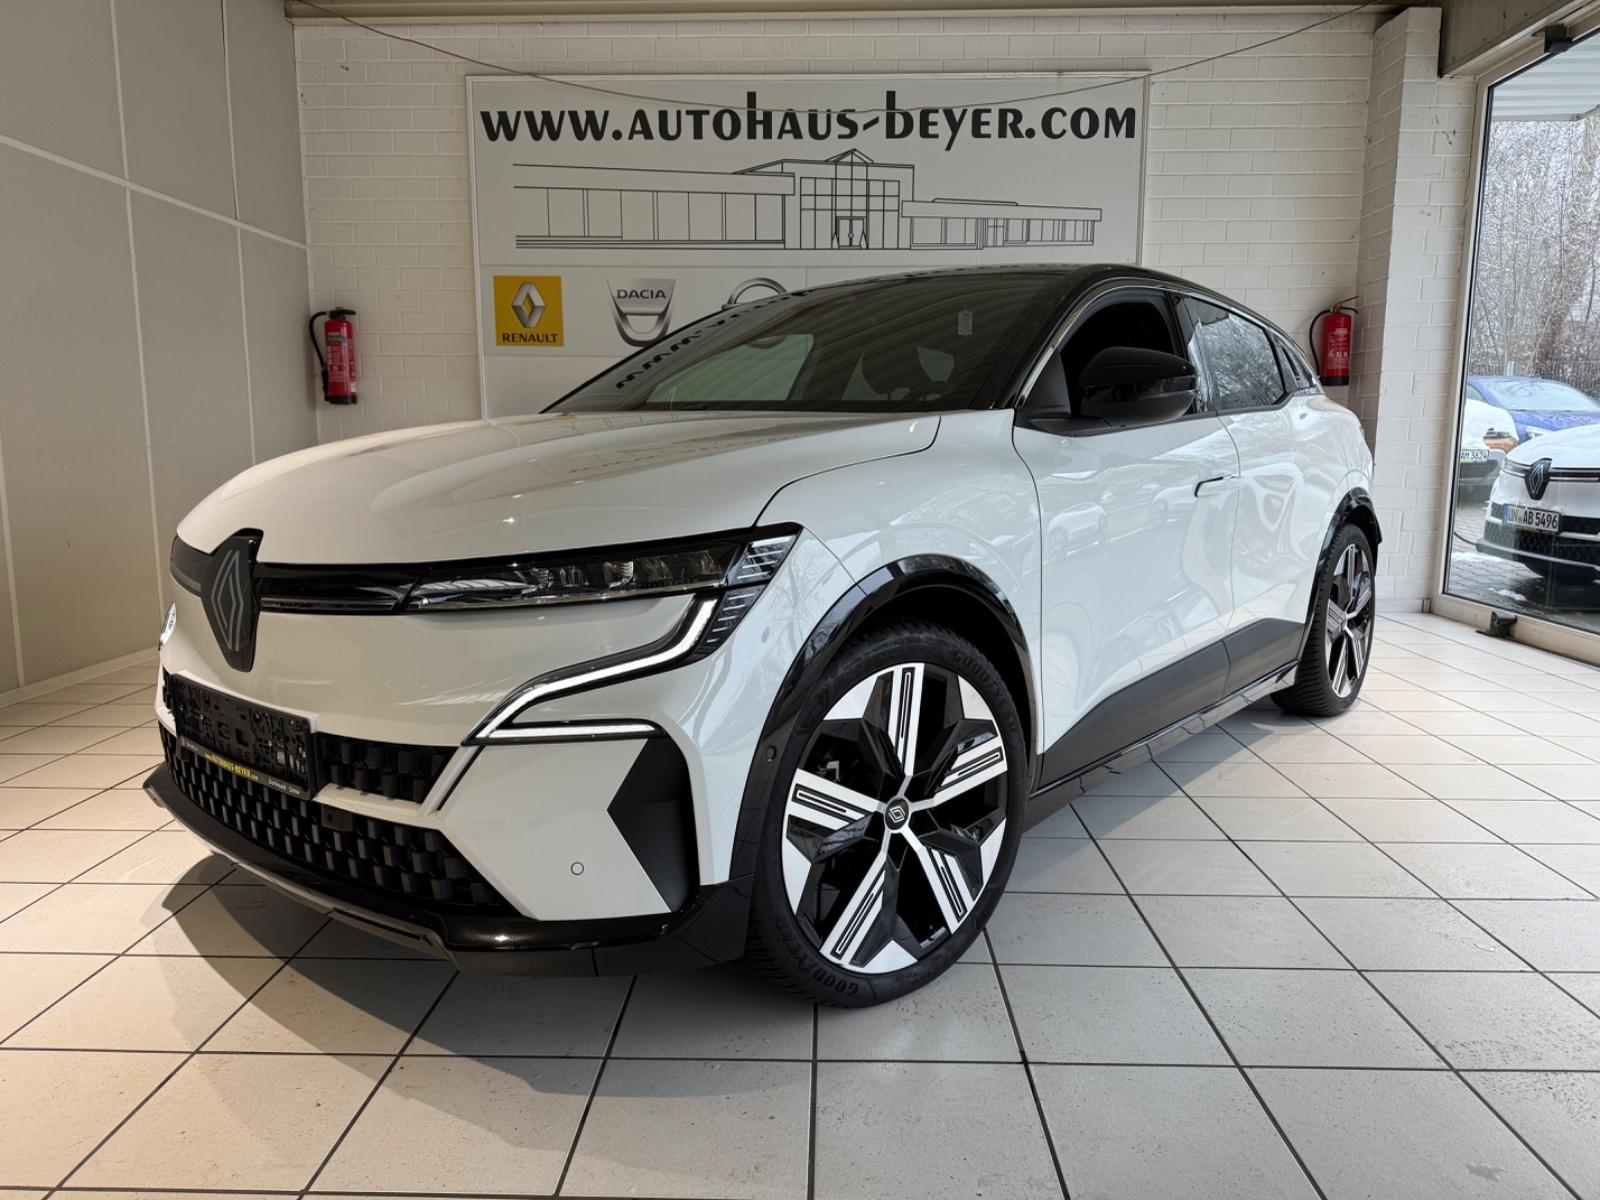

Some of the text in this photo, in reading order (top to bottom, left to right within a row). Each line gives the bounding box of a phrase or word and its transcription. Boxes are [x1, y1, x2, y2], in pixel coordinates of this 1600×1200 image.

[616, 288, 668, 300] DACIA
[501, 332, 560, 344] RENAULT
[1523, 510, 1534, 525] AB
[1535, 512, 1558, 529] 5496
